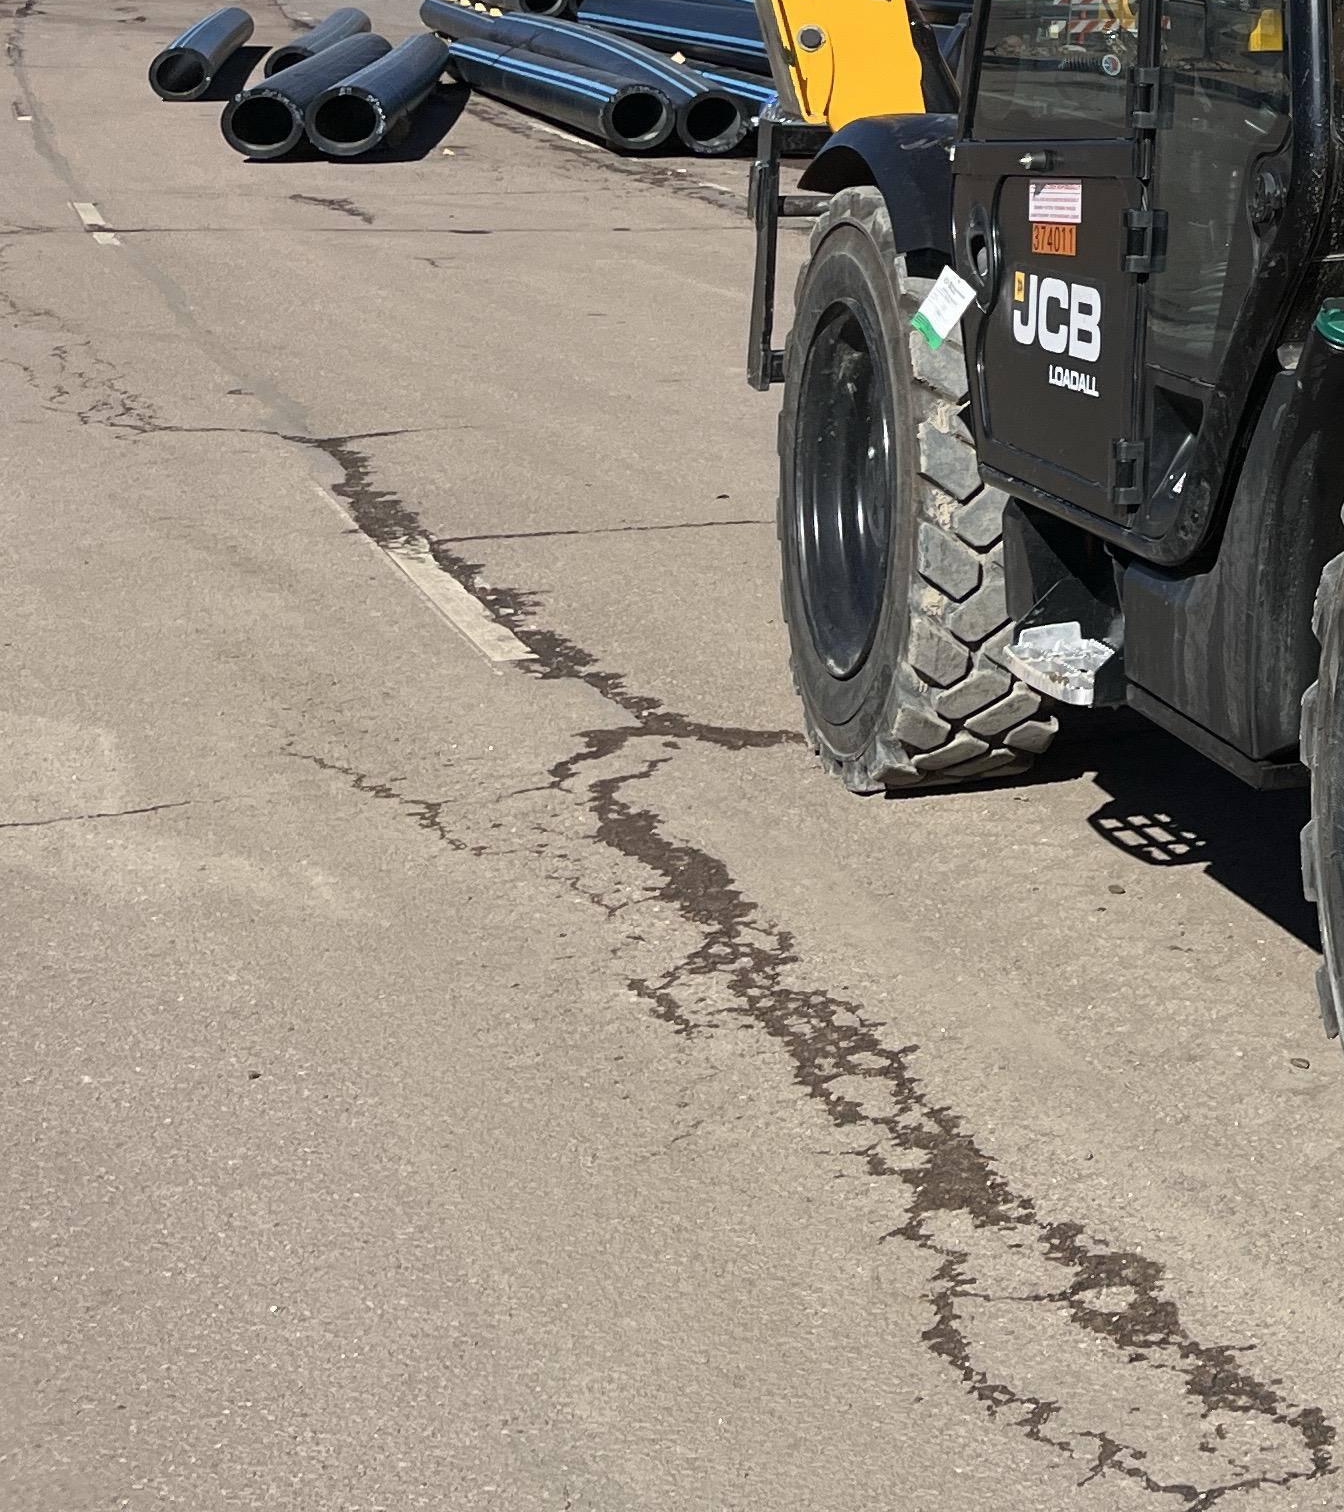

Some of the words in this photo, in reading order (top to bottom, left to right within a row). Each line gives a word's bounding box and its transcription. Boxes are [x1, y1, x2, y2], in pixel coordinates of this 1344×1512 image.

[1032, 225, 1074, 253] 374011
[1012, 273, 1102, 362] JCB
[1049, 364, 1100, 397] LOADALL
